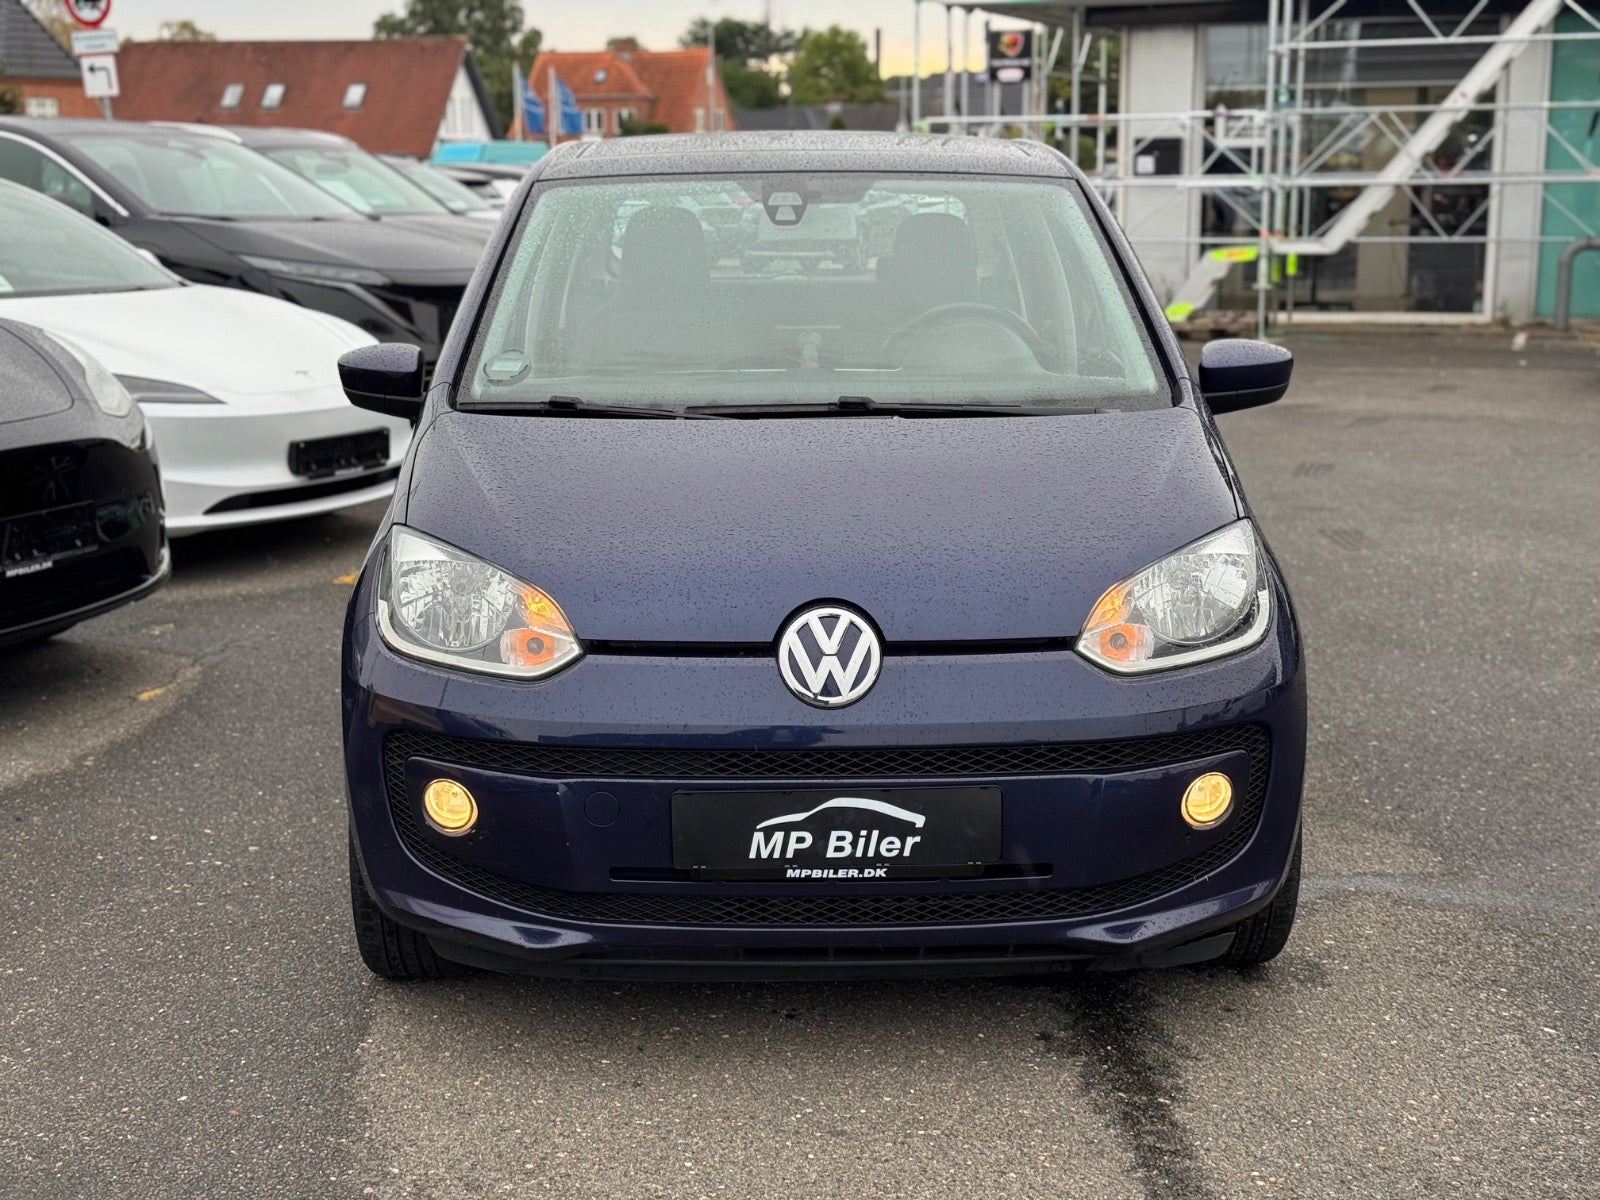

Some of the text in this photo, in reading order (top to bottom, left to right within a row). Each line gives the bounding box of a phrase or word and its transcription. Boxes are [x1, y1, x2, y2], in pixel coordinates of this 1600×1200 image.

[783, 611, 876, 700] VW
[748, 830, 922, 859] MP Biler
[785, 867, 888, 879] MPBILER.DK
